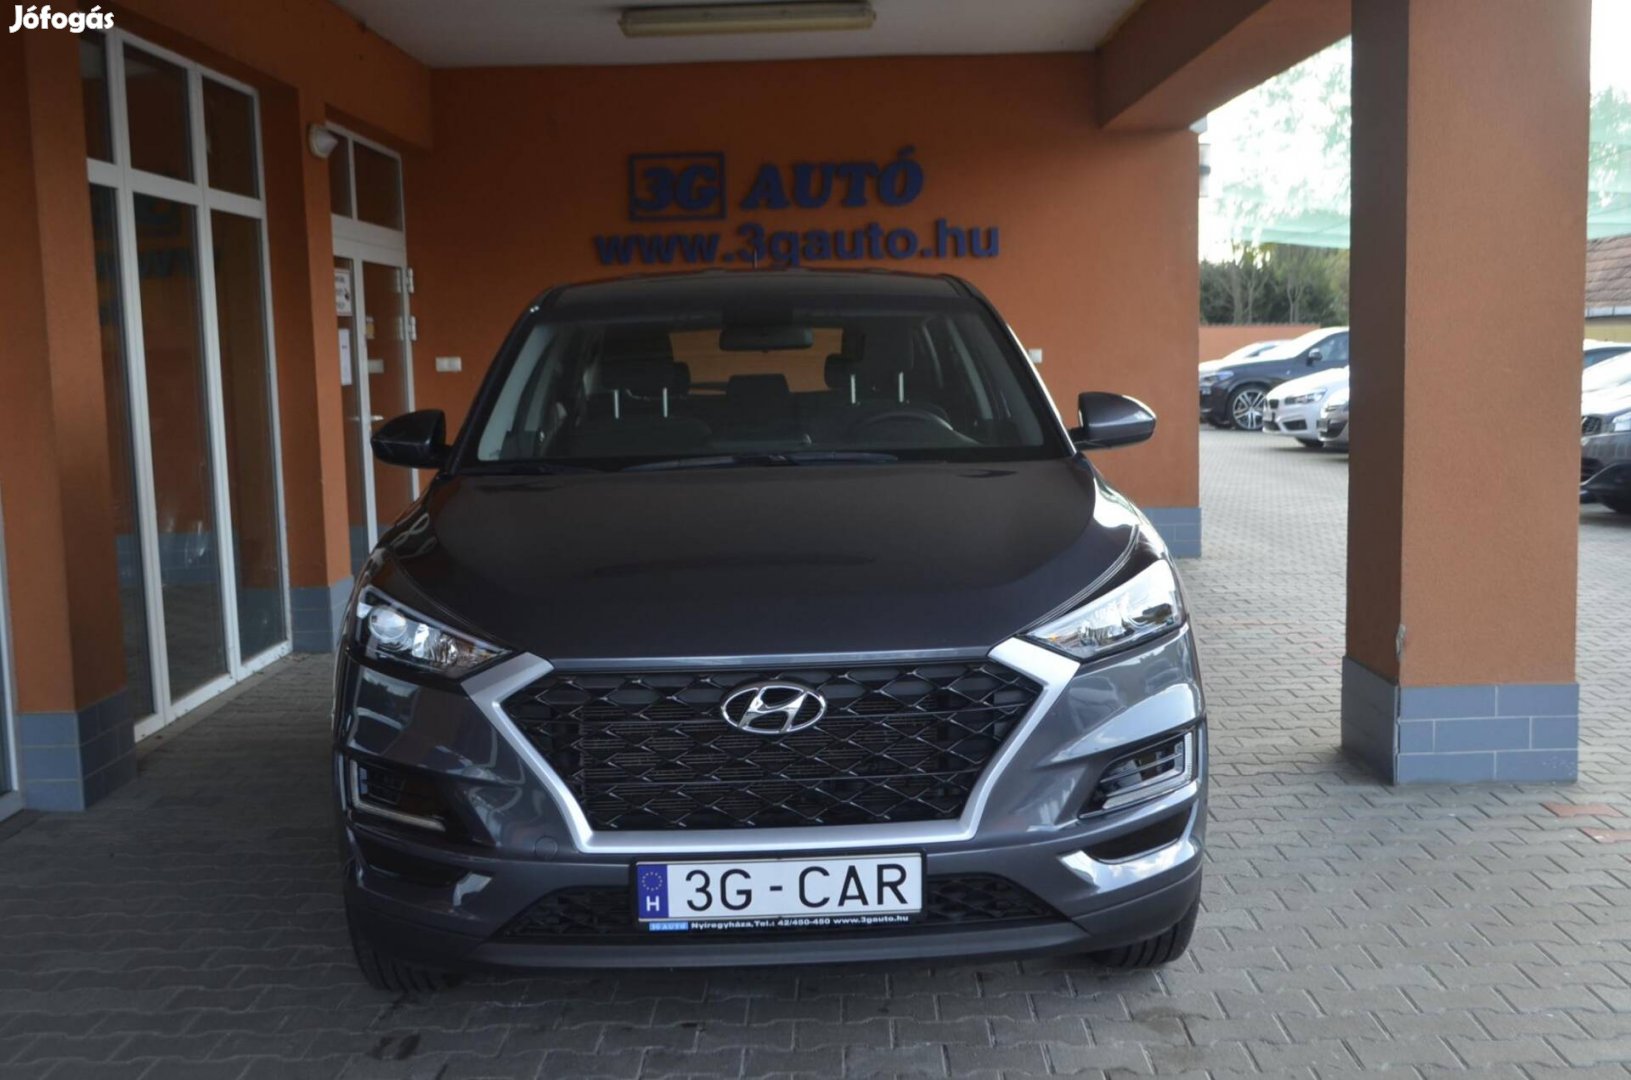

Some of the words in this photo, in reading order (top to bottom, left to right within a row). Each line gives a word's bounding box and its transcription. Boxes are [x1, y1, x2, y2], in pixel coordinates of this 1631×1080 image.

[633, 165, 719, 211] 3G
[741, 146, 925, 210] AUTÓ
[595, 219, 999, 266] www.3gauto.hu
[646, 896, 660, 911] H
